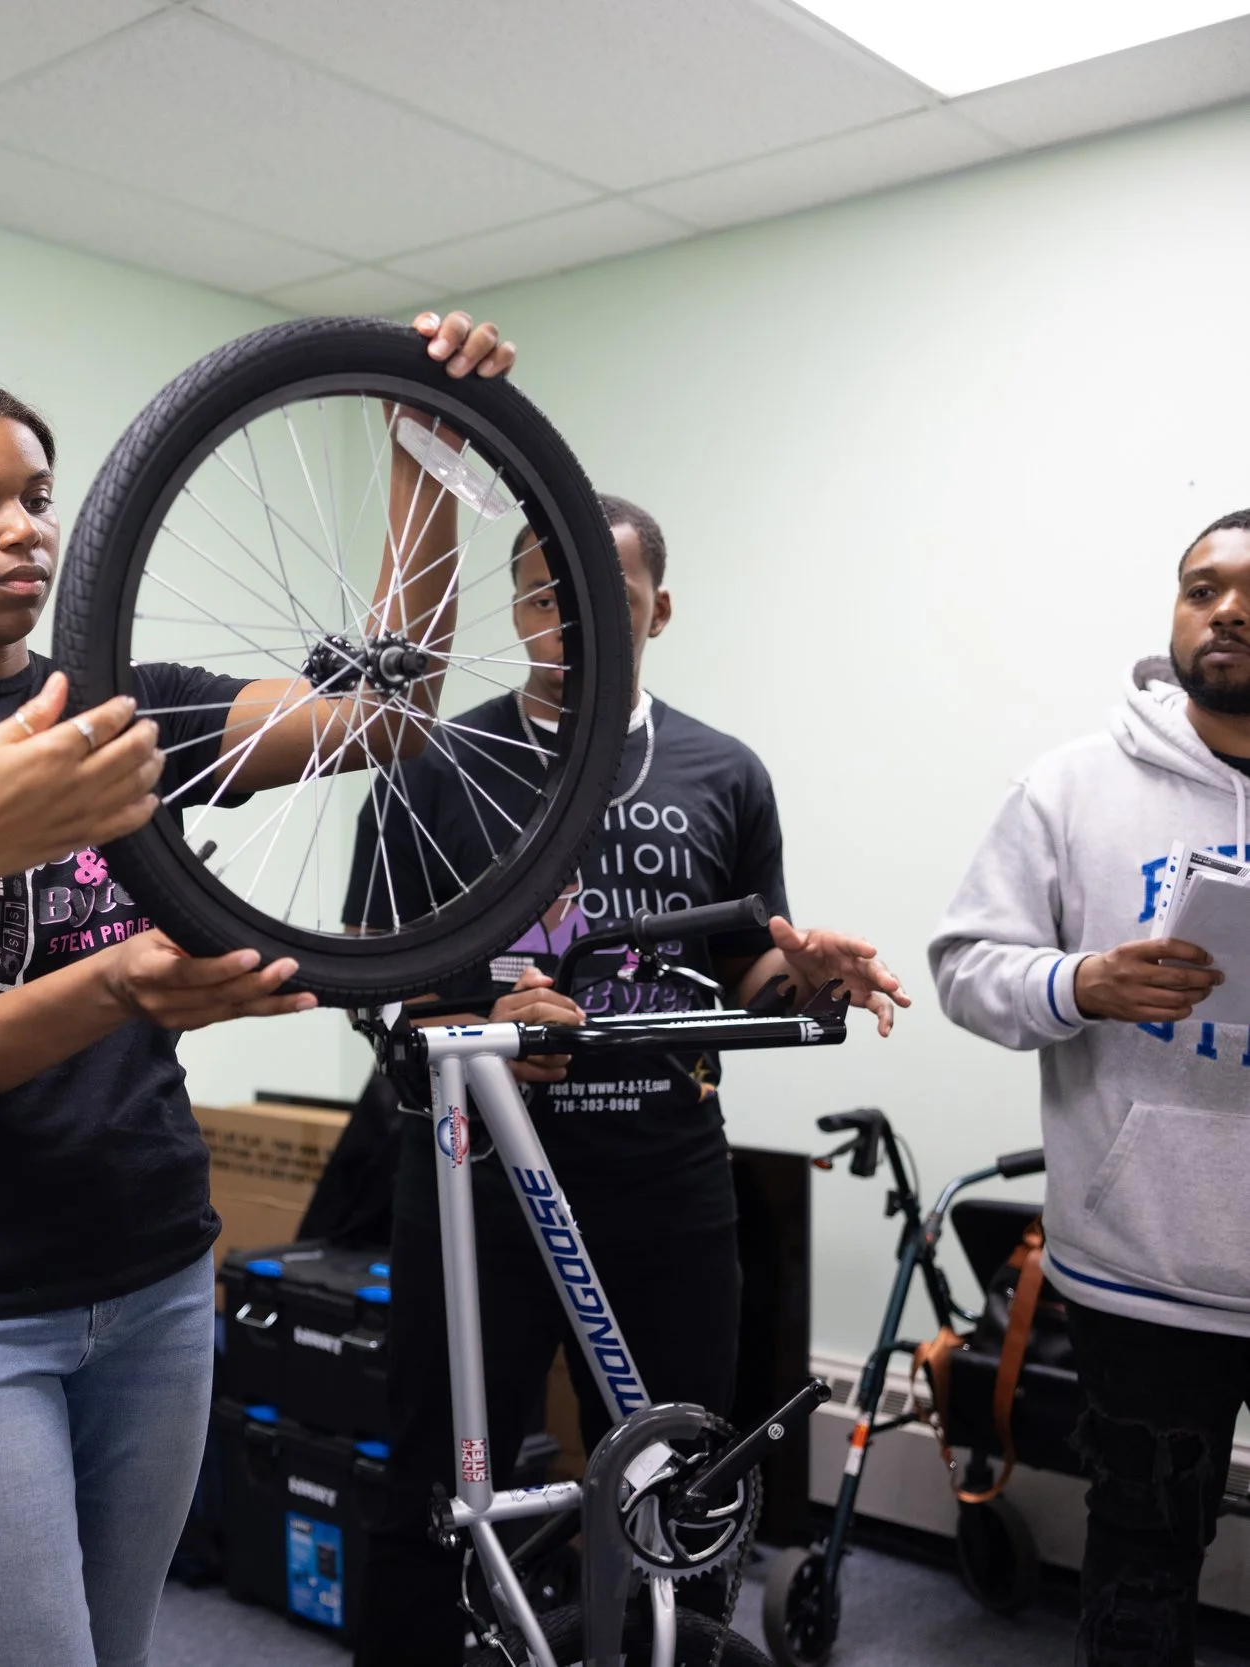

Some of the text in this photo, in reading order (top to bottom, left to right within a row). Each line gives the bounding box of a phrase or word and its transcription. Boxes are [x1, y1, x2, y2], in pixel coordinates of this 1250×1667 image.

[48, 930, 95, 955] STEM
[571, 1082, 585, 1096] by
[512, 1165, 646, 1417] MONGOOSE
[471, 1439, 486, 1482] STEM
